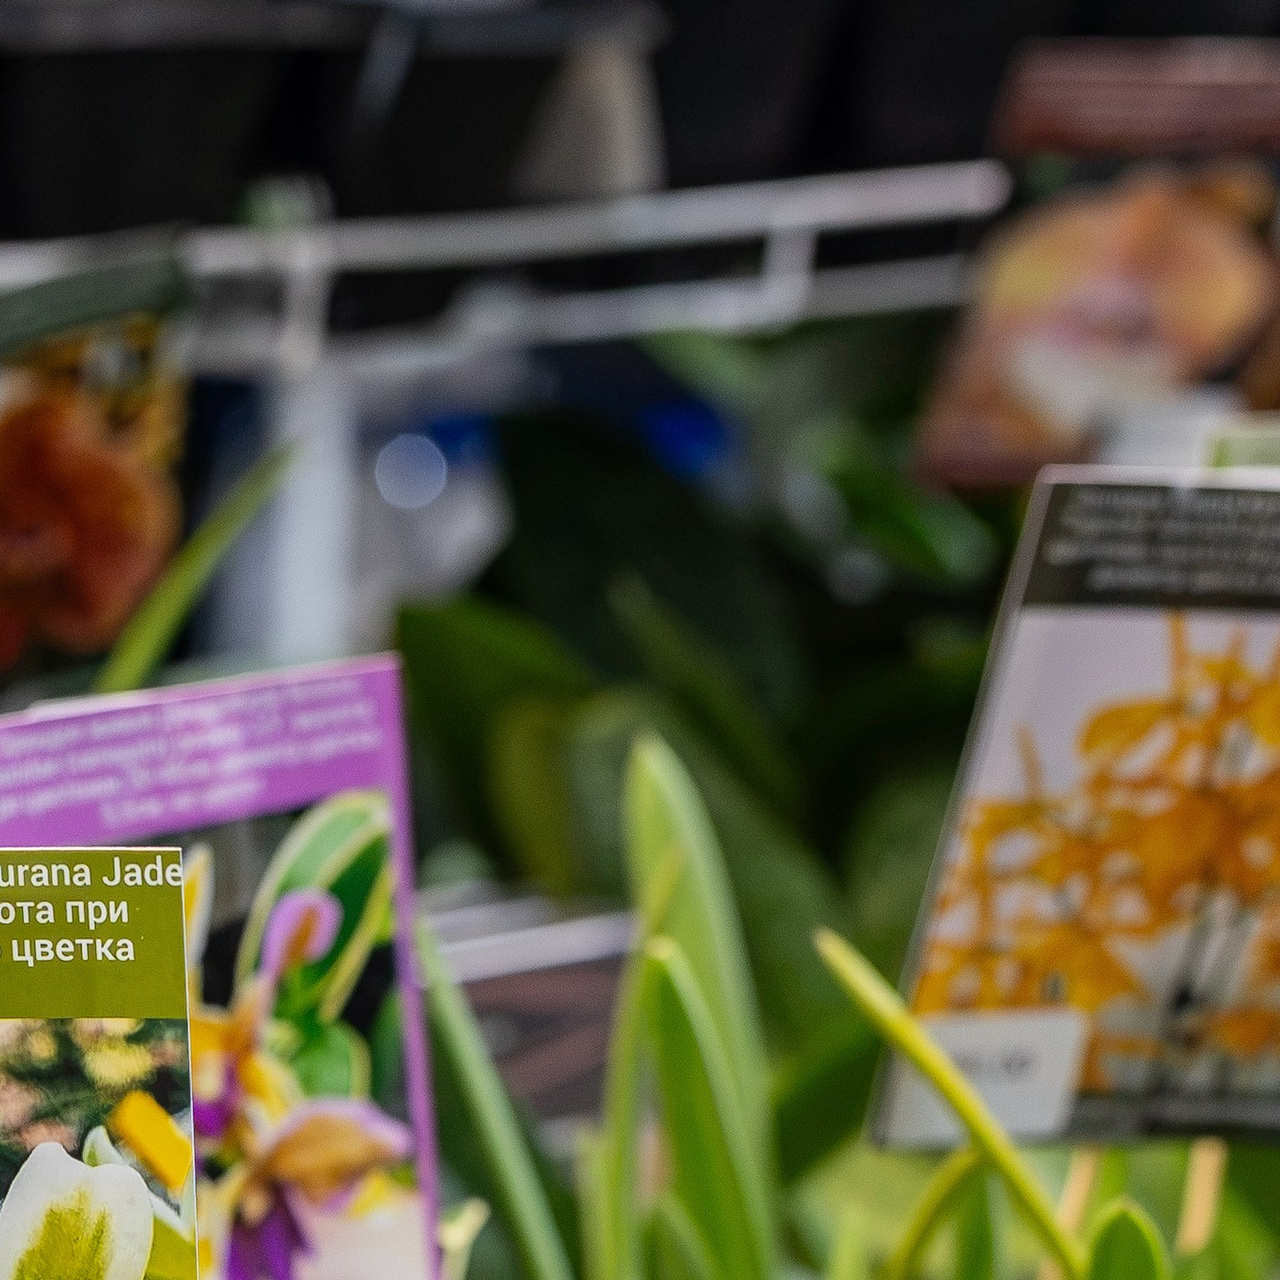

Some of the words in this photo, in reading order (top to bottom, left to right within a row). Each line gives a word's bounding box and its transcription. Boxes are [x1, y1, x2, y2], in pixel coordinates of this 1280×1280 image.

[102, 855, 183, 887] Jade
[66, 900, 129, 931] при
[11, 938, 135, 968] цветка
